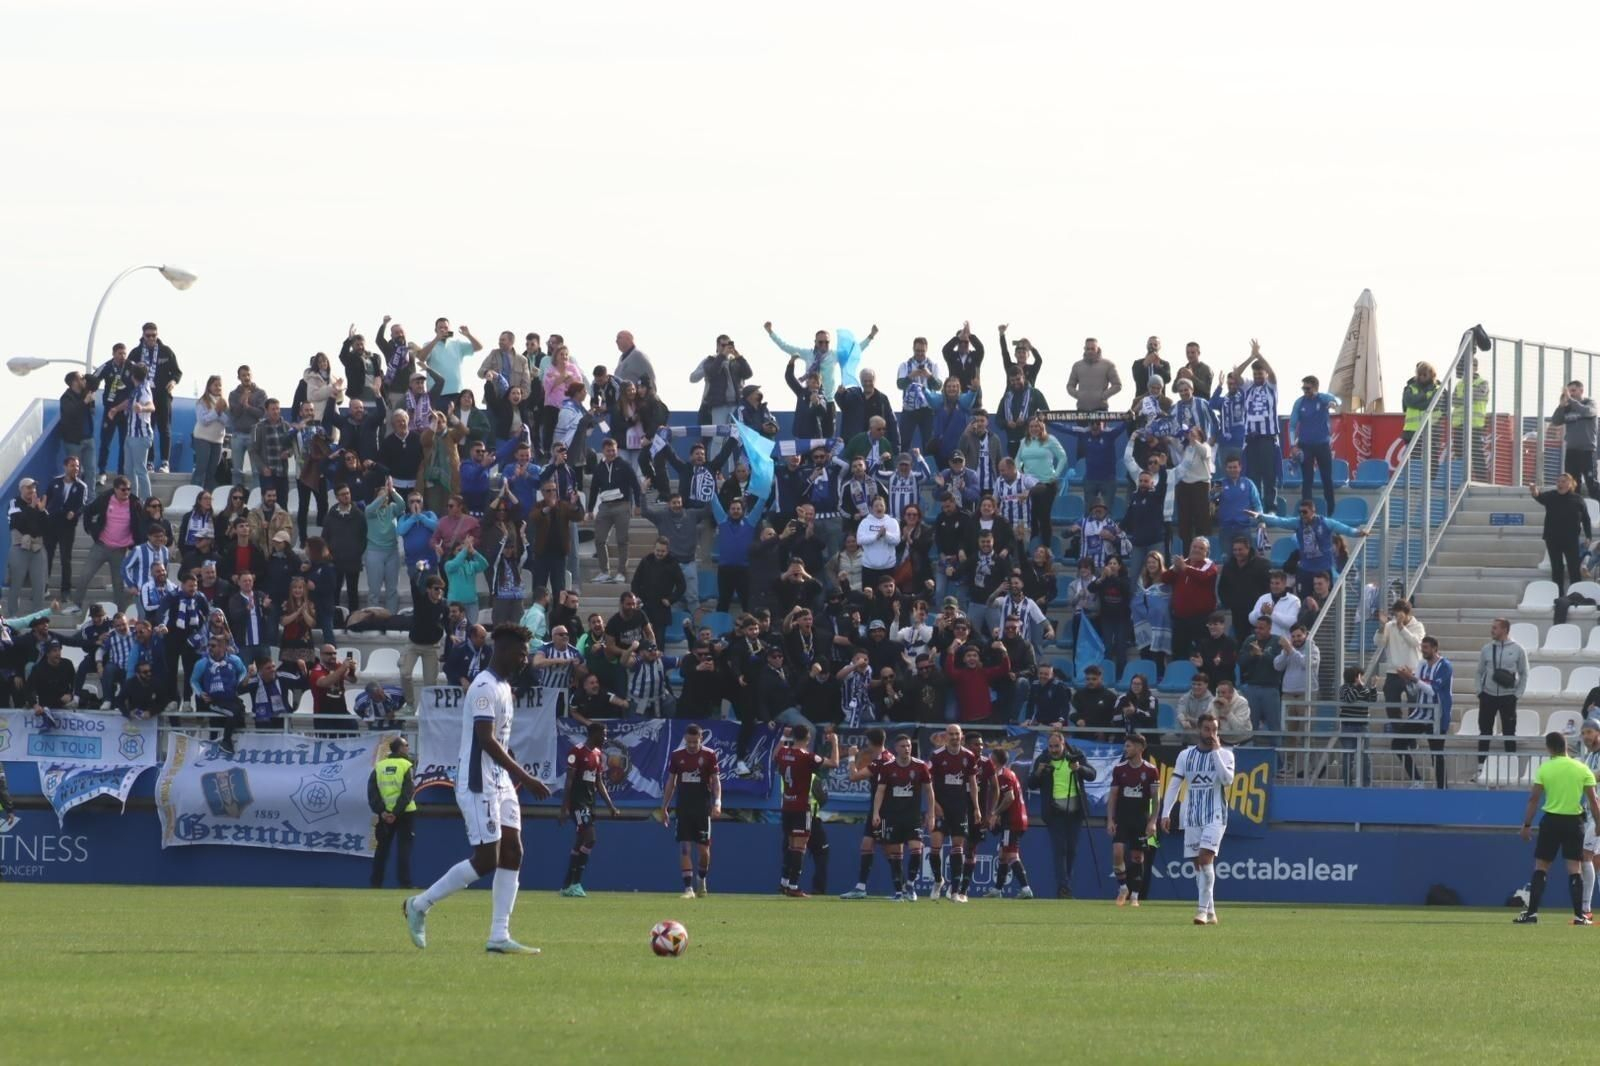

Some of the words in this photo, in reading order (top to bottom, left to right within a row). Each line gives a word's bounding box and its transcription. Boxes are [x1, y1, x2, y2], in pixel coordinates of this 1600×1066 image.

[433, 687, 463, 708] PEP
[24, 717, 106, 732] HOJEROS
[33, 740, 55, 752] ON
[60, 741, 96, 754] TOUR
[822, 779, 871, 793] ANSAR
[255, 808, 281, 820] 1889
[174, 812, 366, 851] Grandeza
[1167, 856, 1358, 881] coectabalear
